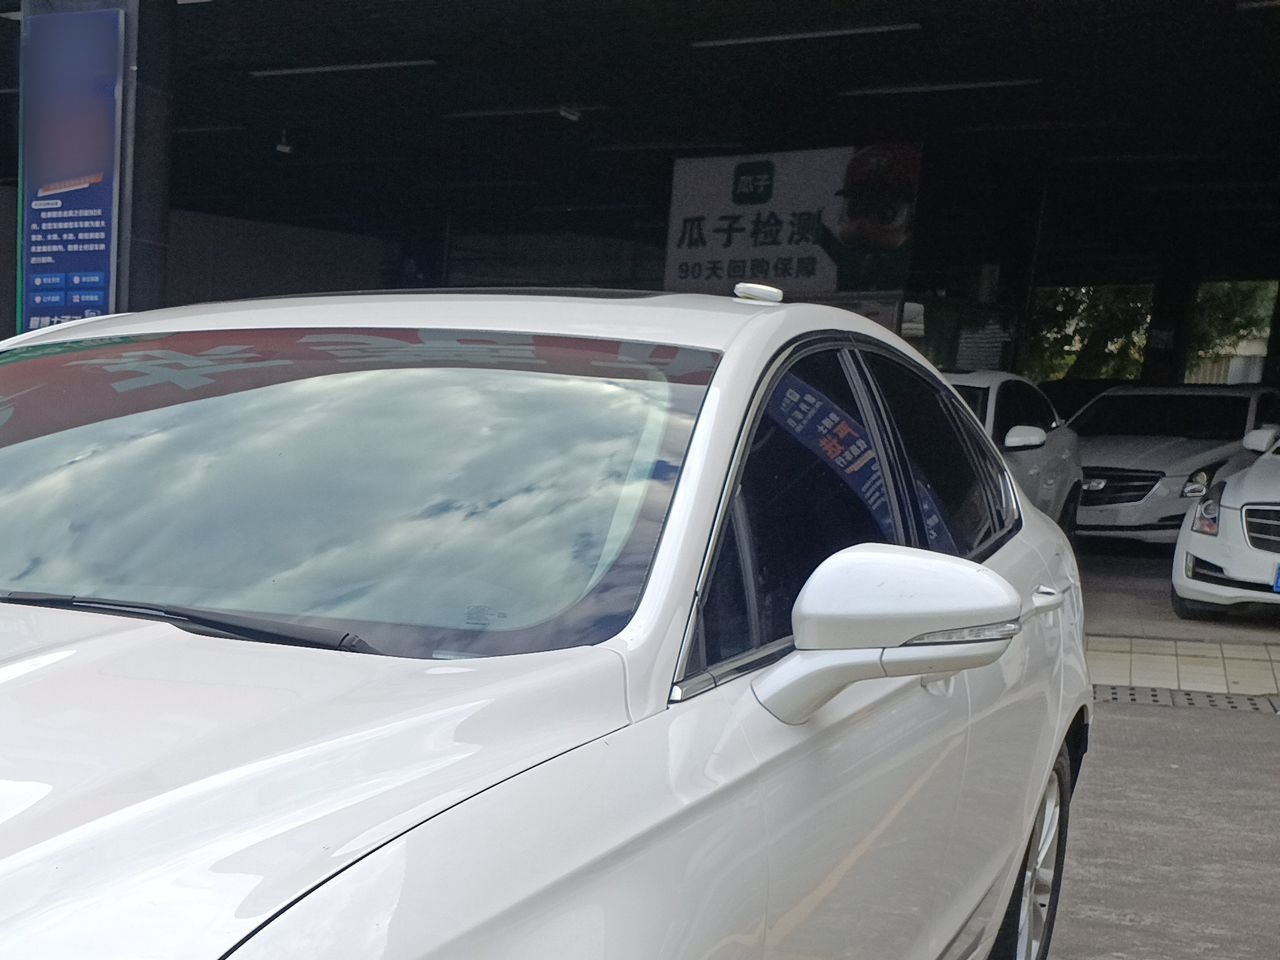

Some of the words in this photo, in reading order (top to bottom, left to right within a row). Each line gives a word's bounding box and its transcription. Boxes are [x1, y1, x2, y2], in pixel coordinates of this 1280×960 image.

[735, 174, 770, 194] 瓜子
[677, 207, 824, 249] 瓜子检测
[677, 255, 818, 281] 90天回购保障
